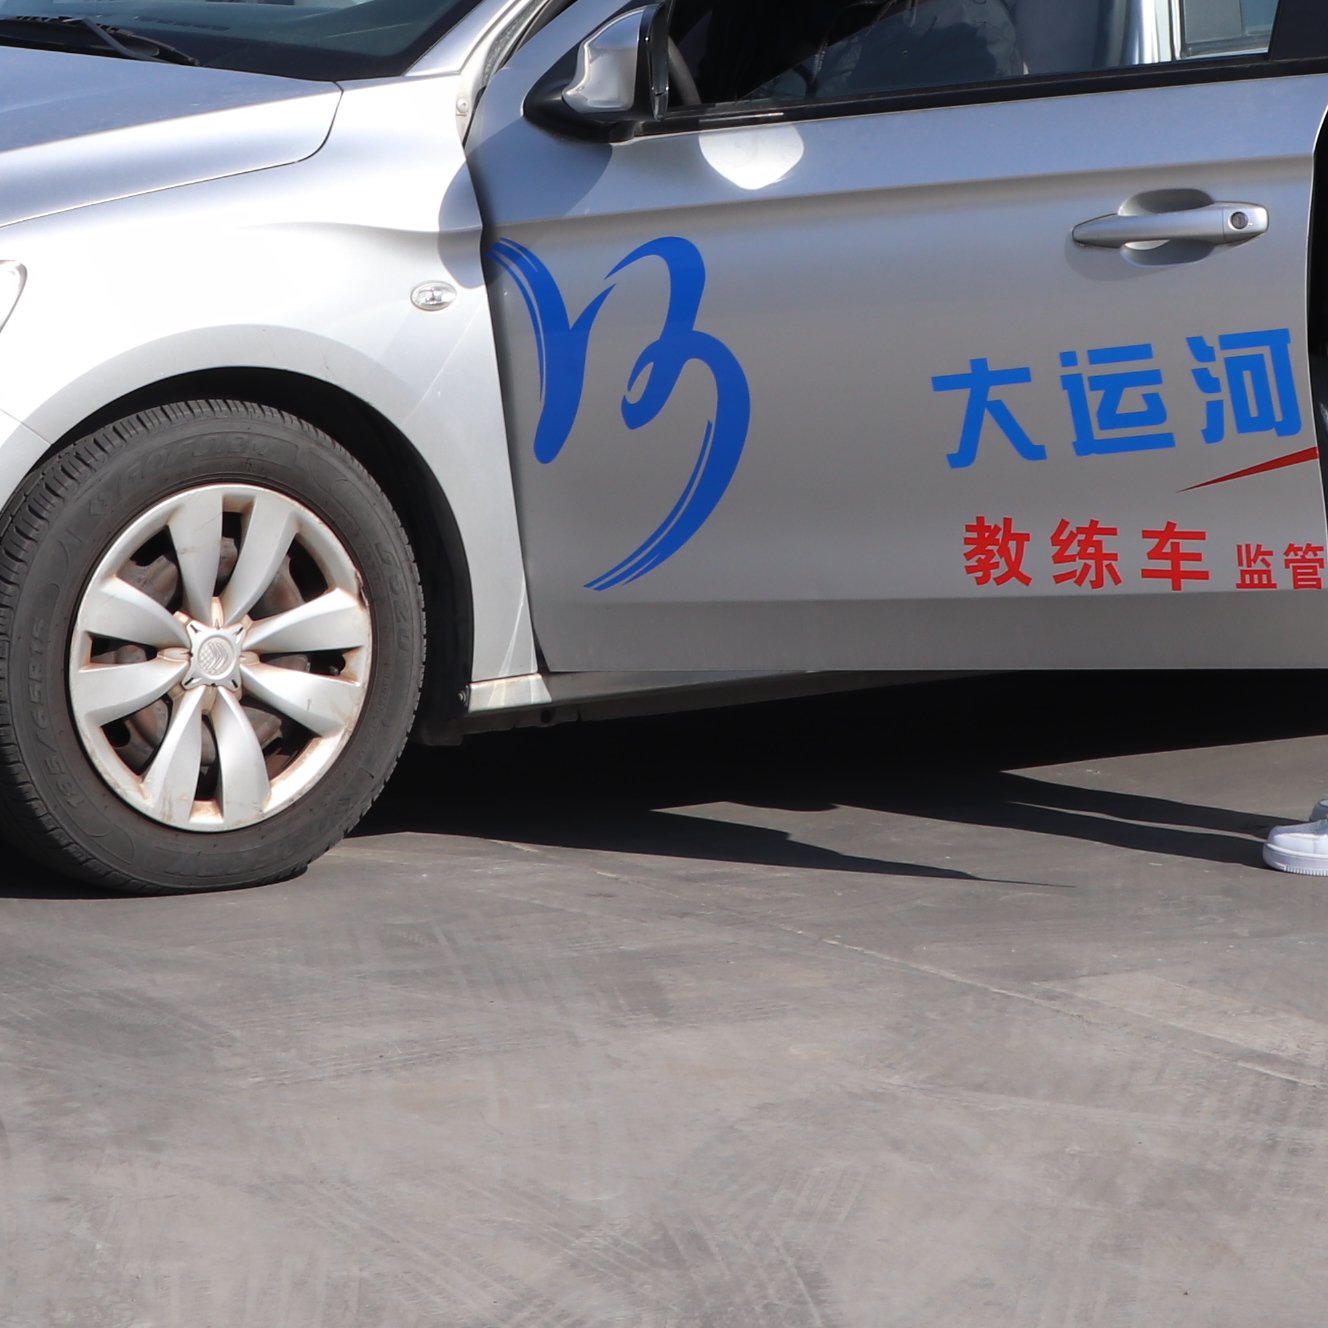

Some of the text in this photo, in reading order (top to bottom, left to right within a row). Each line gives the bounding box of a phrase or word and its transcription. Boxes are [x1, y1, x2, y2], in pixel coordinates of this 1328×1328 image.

[931, 328, 1302, 469] 大运河
[963, 515, 1325, 591] 教练车 监管
